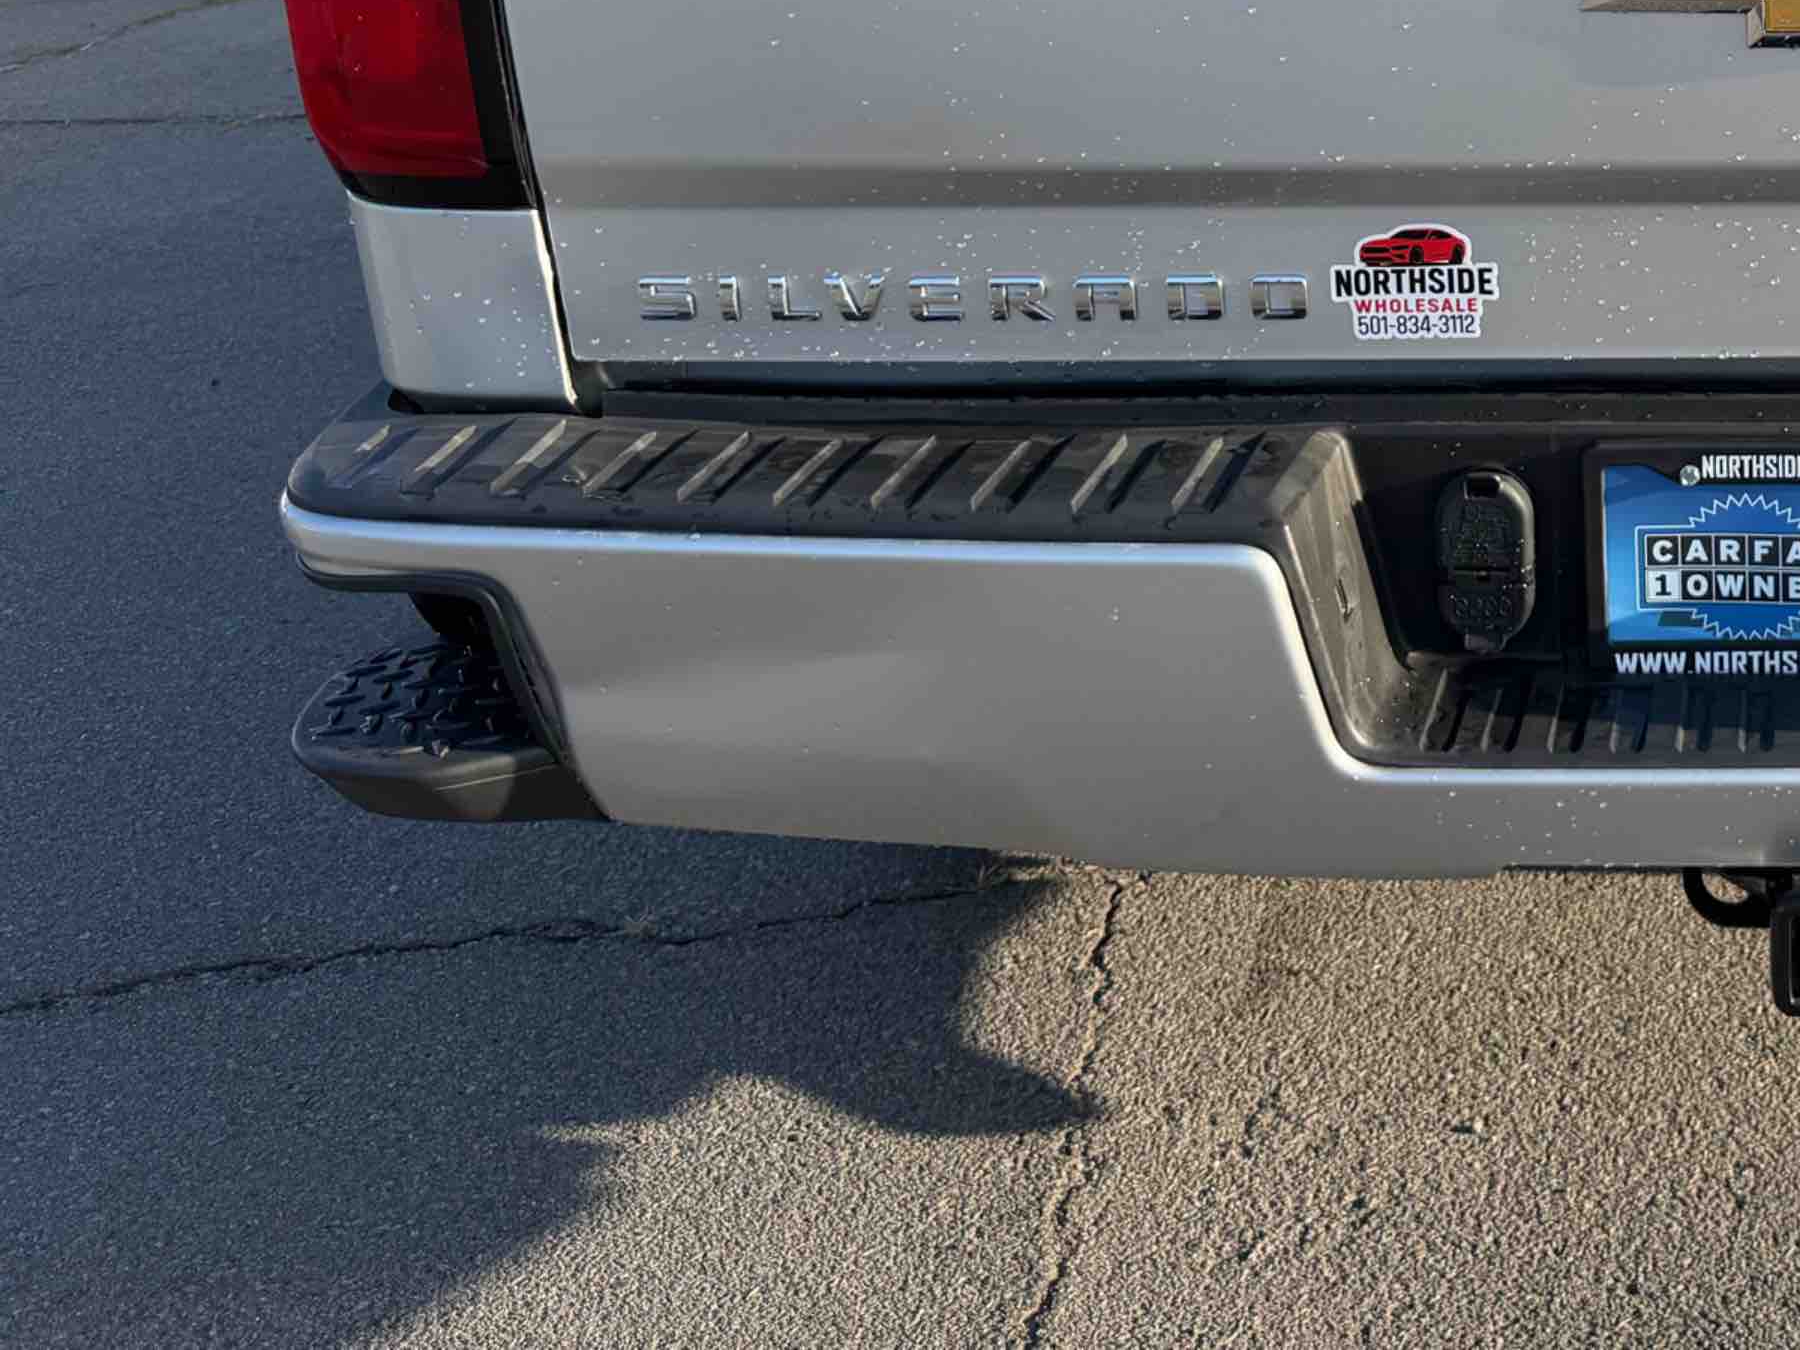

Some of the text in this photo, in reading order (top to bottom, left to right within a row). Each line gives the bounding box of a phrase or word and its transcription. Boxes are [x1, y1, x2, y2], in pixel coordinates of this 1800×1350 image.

[1335, 268, 1494, 297] NORTHSIDE
[638, 274, 1309, 321] SILVERADO
[1354, 298, 1478, 313] WHOLESALE
[1358, 314, 1476, 335] 501-834-3112
